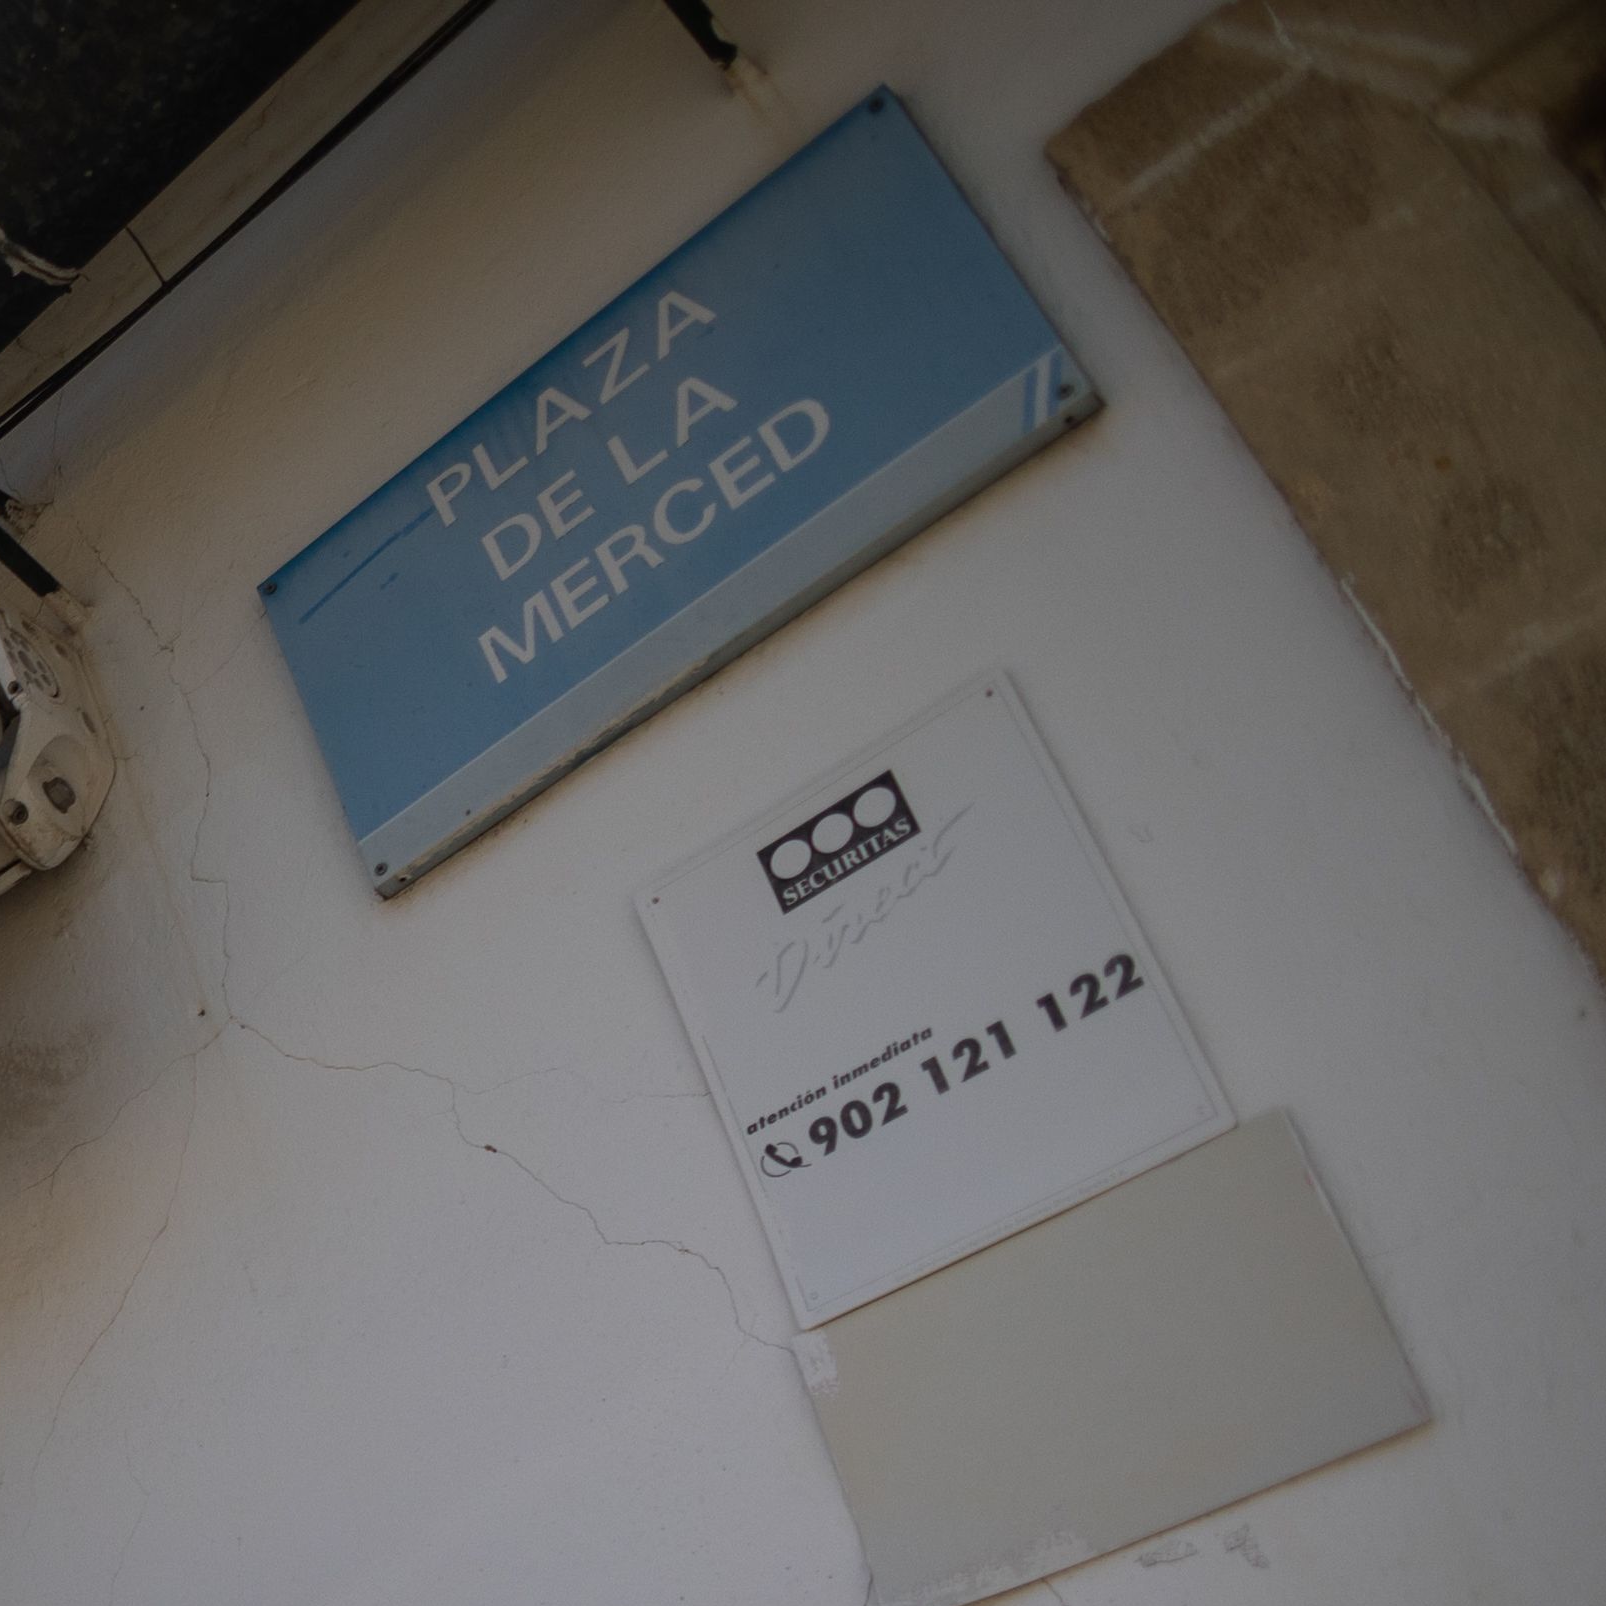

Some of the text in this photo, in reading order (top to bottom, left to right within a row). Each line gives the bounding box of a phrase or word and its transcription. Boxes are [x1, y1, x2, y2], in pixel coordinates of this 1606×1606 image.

[426, 290, 717, 528] PLAZA
[482, 376, 738, 581] DE LA
[478, 399, 831, 684] MERCED
[782, 816, 912, 907] SECURITAS
[746, 1026, 933, 1135] atención inmediata
[808, 953, 1145, 1157] 902 121 122
